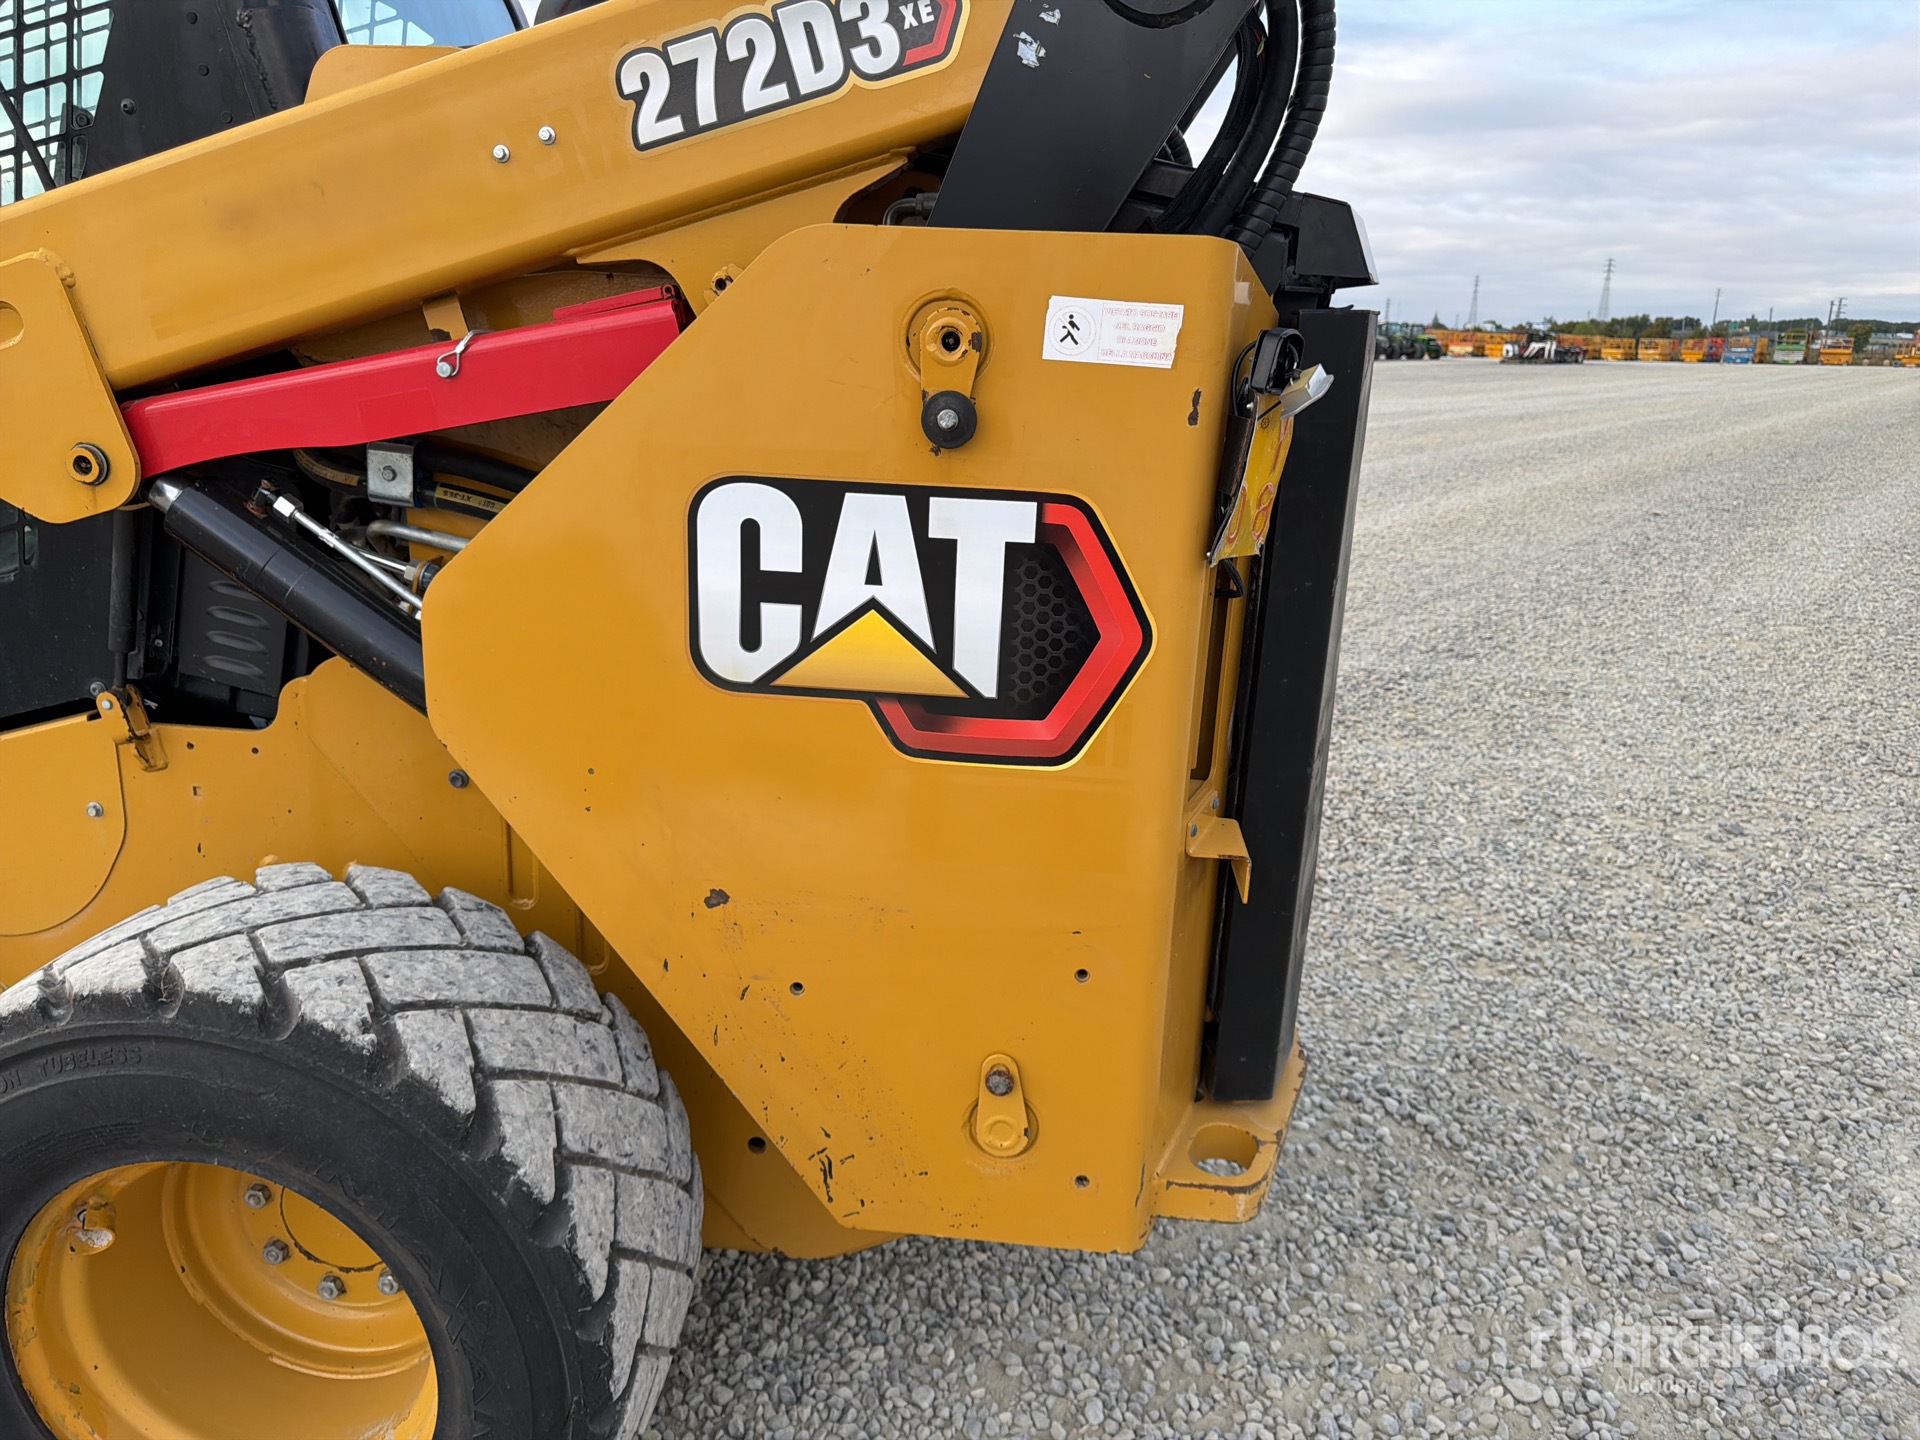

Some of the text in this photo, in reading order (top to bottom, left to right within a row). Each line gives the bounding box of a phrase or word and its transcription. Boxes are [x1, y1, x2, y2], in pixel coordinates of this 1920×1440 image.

[620, 0, 935, 145] 272D3 XE
[1132, 323, 1166, 333] RAGGIO
[697, 482, 1037, 699] CAT
[37, 1046, 142, 1077] TUBELESS
